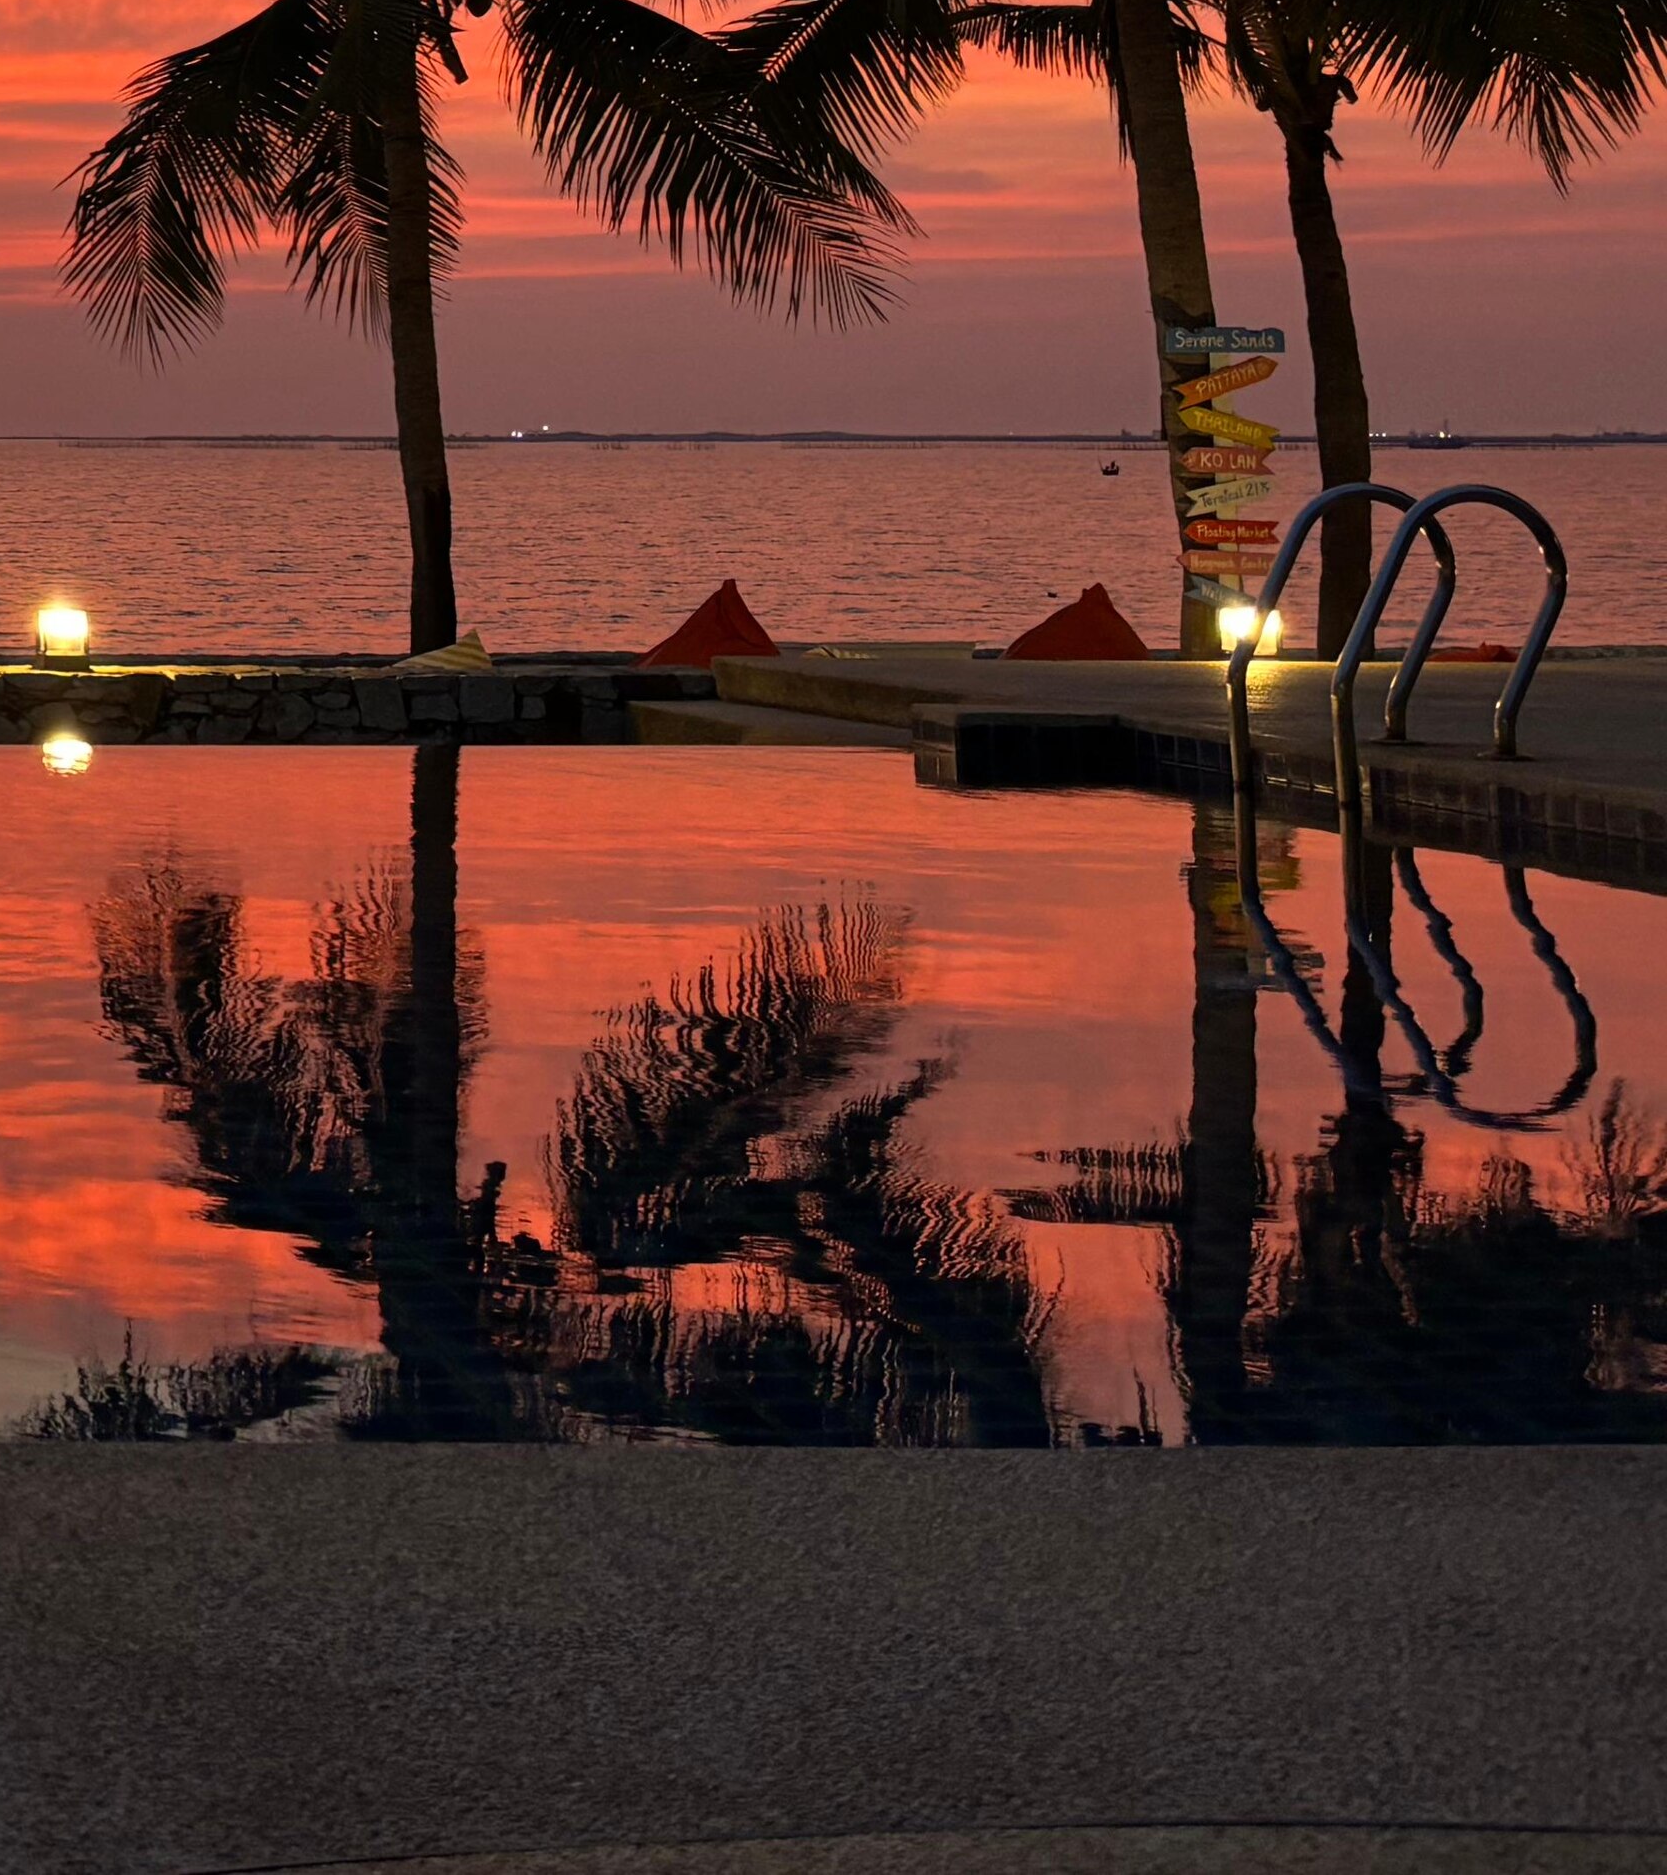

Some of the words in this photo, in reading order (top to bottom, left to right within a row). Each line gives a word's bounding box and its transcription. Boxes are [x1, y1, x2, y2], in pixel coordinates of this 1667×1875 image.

[1175, 331, 1225, 348] Serene
[1230, 330, 1275, 349] Sands
[1195, 363, 1257, 398] PATTAYA
[1193, 411, 1262, 439] THAILAND
[1200, 452, 1224, 468] KO
[1229, 454, 1256, 469] LAN
[1196, 524, 1235, 540] Floating
[1237, 525, 1269, 538] Market
